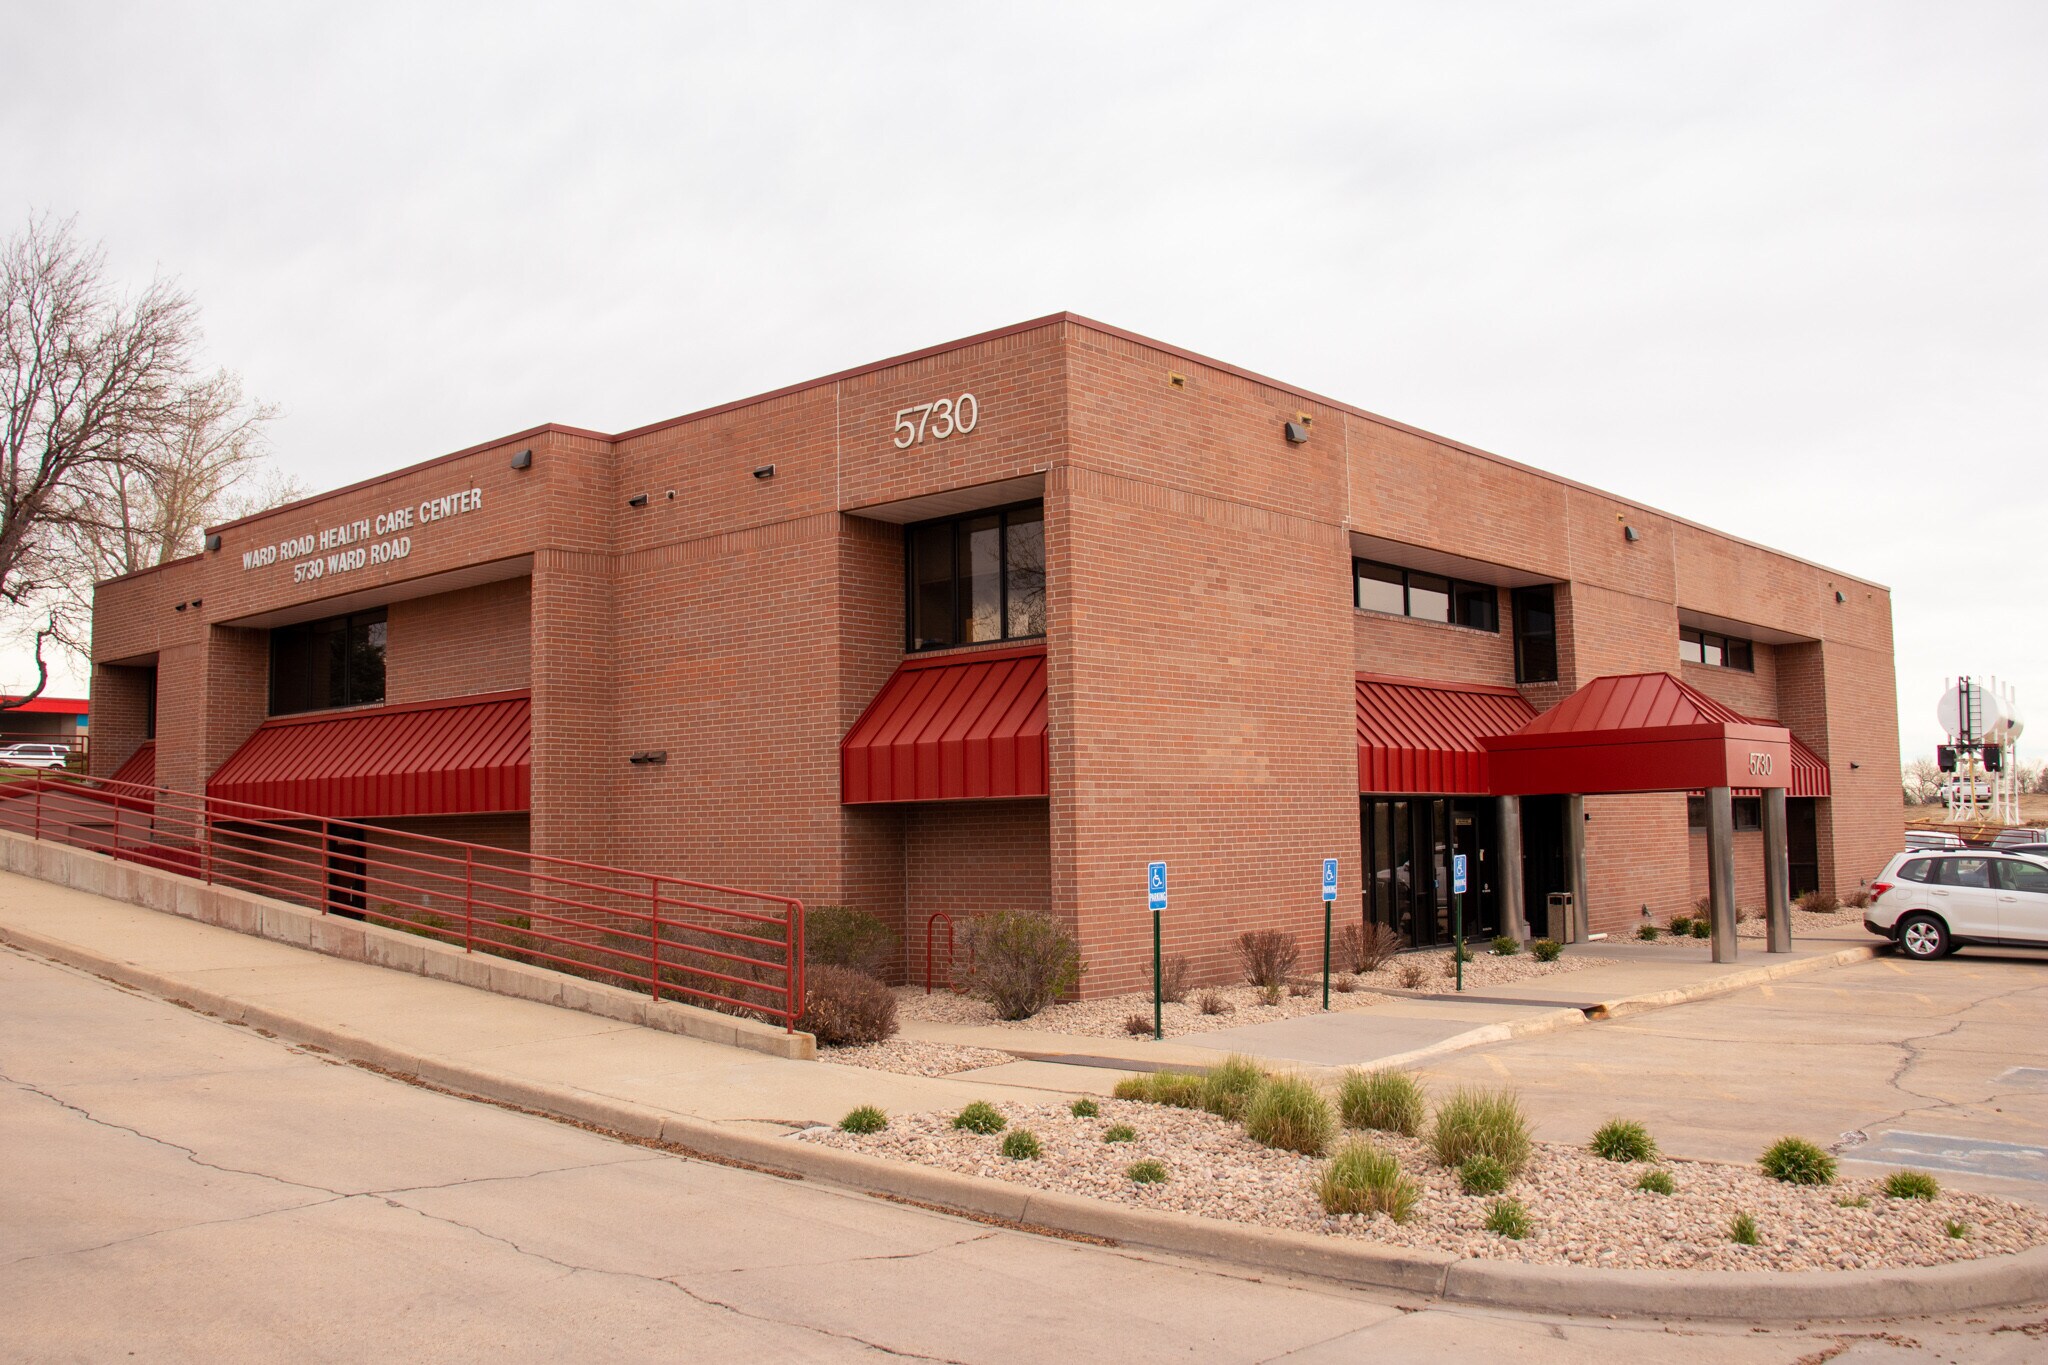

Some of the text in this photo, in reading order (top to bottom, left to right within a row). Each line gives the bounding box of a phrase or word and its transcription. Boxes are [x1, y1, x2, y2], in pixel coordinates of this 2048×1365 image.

[893, 392, 978, 449] 5730
[242, 487, 482, 571] WARD ROAD HEALTH CARE CENTER
[293, 536, 412, 584] 5730 WARD ROAD
[1749, 752, 1773, 776] 5730
